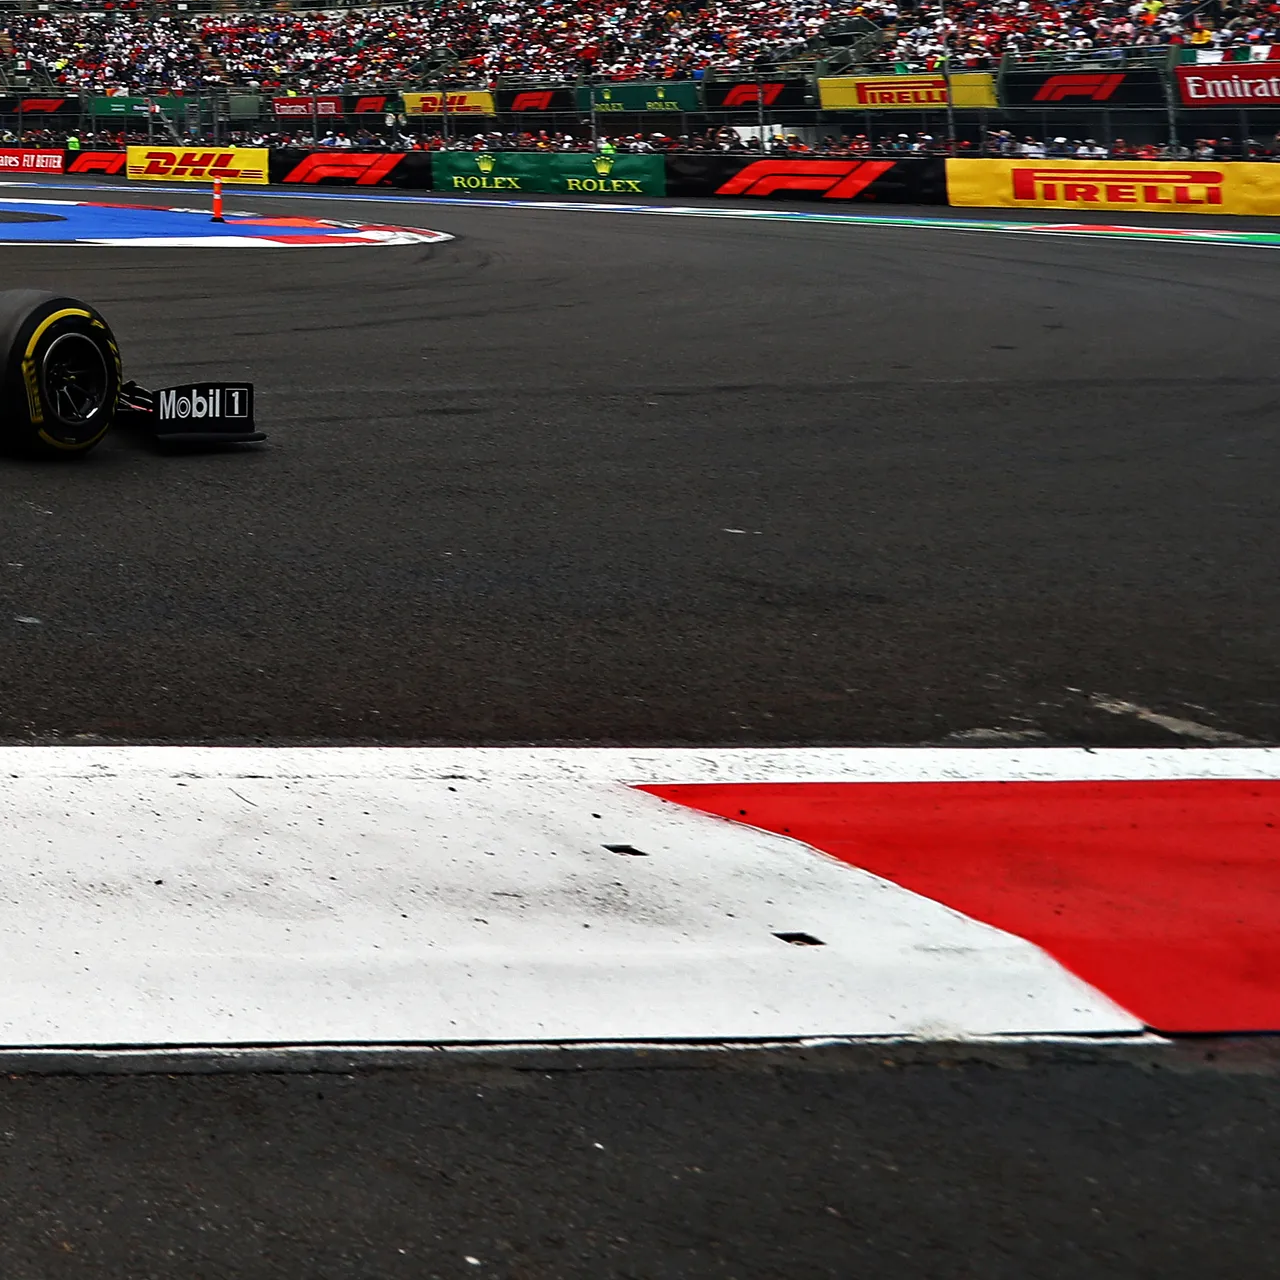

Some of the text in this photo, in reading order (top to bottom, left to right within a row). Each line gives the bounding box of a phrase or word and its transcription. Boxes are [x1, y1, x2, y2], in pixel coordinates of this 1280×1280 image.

[419, 96, 475, 112] DHL
[856, 79, 950, 105] PIRELLI
[22, 154, 35, 168] FLY
[36, 155, 63, 170] BETTER
[143, 151, 242, 178] DHL
[452, 176, 643, 194] ROLEX ROLEX
[1011, 167, 1225, 206] PIRELLI
[159, 388, 241, 420] Mobil 1
